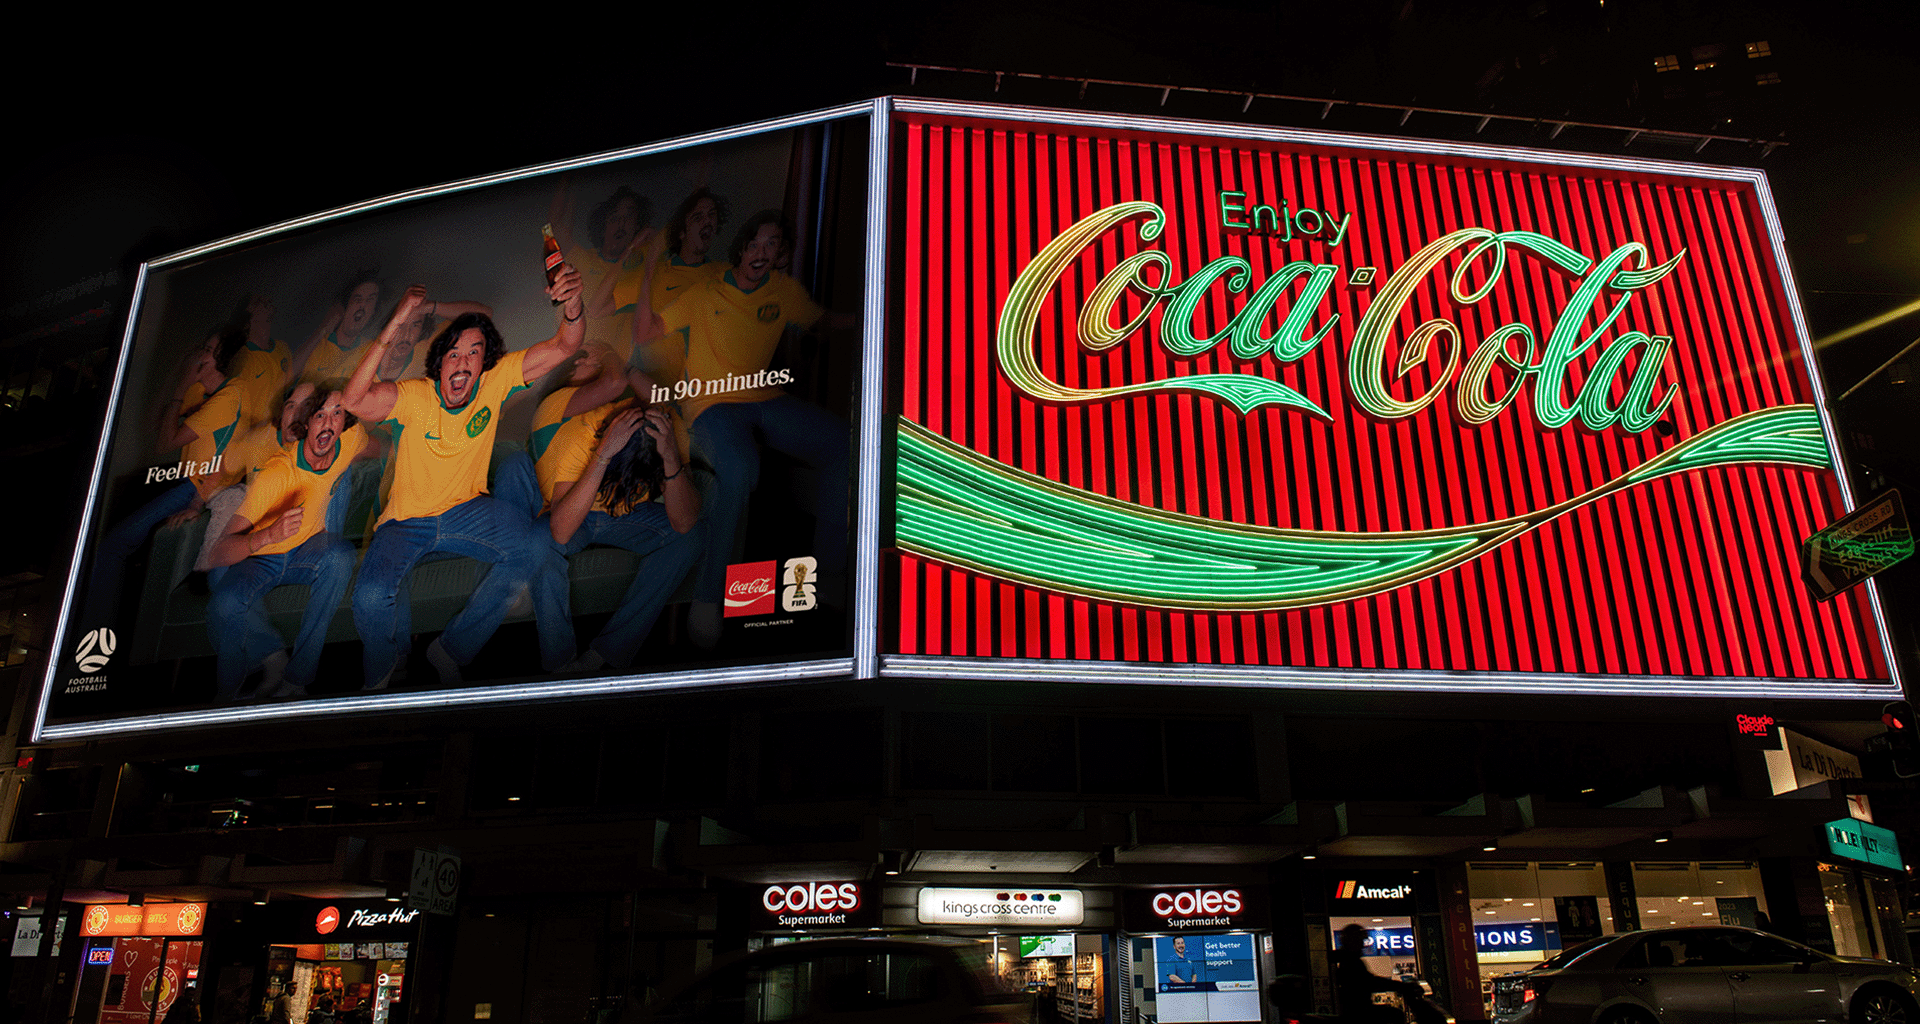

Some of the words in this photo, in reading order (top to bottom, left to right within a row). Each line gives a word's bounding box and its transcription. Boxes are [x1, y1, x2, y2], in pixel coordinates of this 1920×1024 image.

[1220, 190, 1352, 247] Enjoy
[650, 383, 670, 404] in
[674, 378, 701, 400] 90
[704, 368, 795, 396] minutes.
[144, 461, 183, 485] Feel
[183, 460, 197, 479] it
[198, 455, 223, 476] all
[1854, 512, 1879, 532] CROSS
[1880, 503, 1892, 517] RD
[769, 619, 794, 627] PARTNER
[68, 675, 107, 686] FOOTBALL
[64, 683, 107, 694] AUSTRALIA
[1736, 714, 1774, 726] Claude
[1738, 722, 1767, 734] Neon
[1797, 745, 1814, 772] La
[1813, 751, 1829, 777] Di
[440, 869, 456, 887] 40
[762, 882, 858, 912] coles
[1356, 885, 1412, 899] Amcal+
[432, 898, 455, 912] AREA
[943, 900, 978, 917] kings
[980, 904, 1012, 915] cross
[1013, 902, 1057, 915] centre
[1152, 888, 1243, 916] coles
[113, 914, 143, 925] BURGER
[147, 913, 168, 924] BITES
[347, 908, 388, 928] Pizza
[387, 907, 420, 924] Hut
[778, 913, 846, 927] Supermarket
[1167, 915, 1231, 929] Supermarket
[1721, 914, 1741, 926] Flu
[18, 930, 29, 939] La
[1205, 942, 1218, 950] Get
[1219, 941, 1241, 949] better
[91, 950, 111, 962] OPEN
[1206, 959, 1233, 967] support
